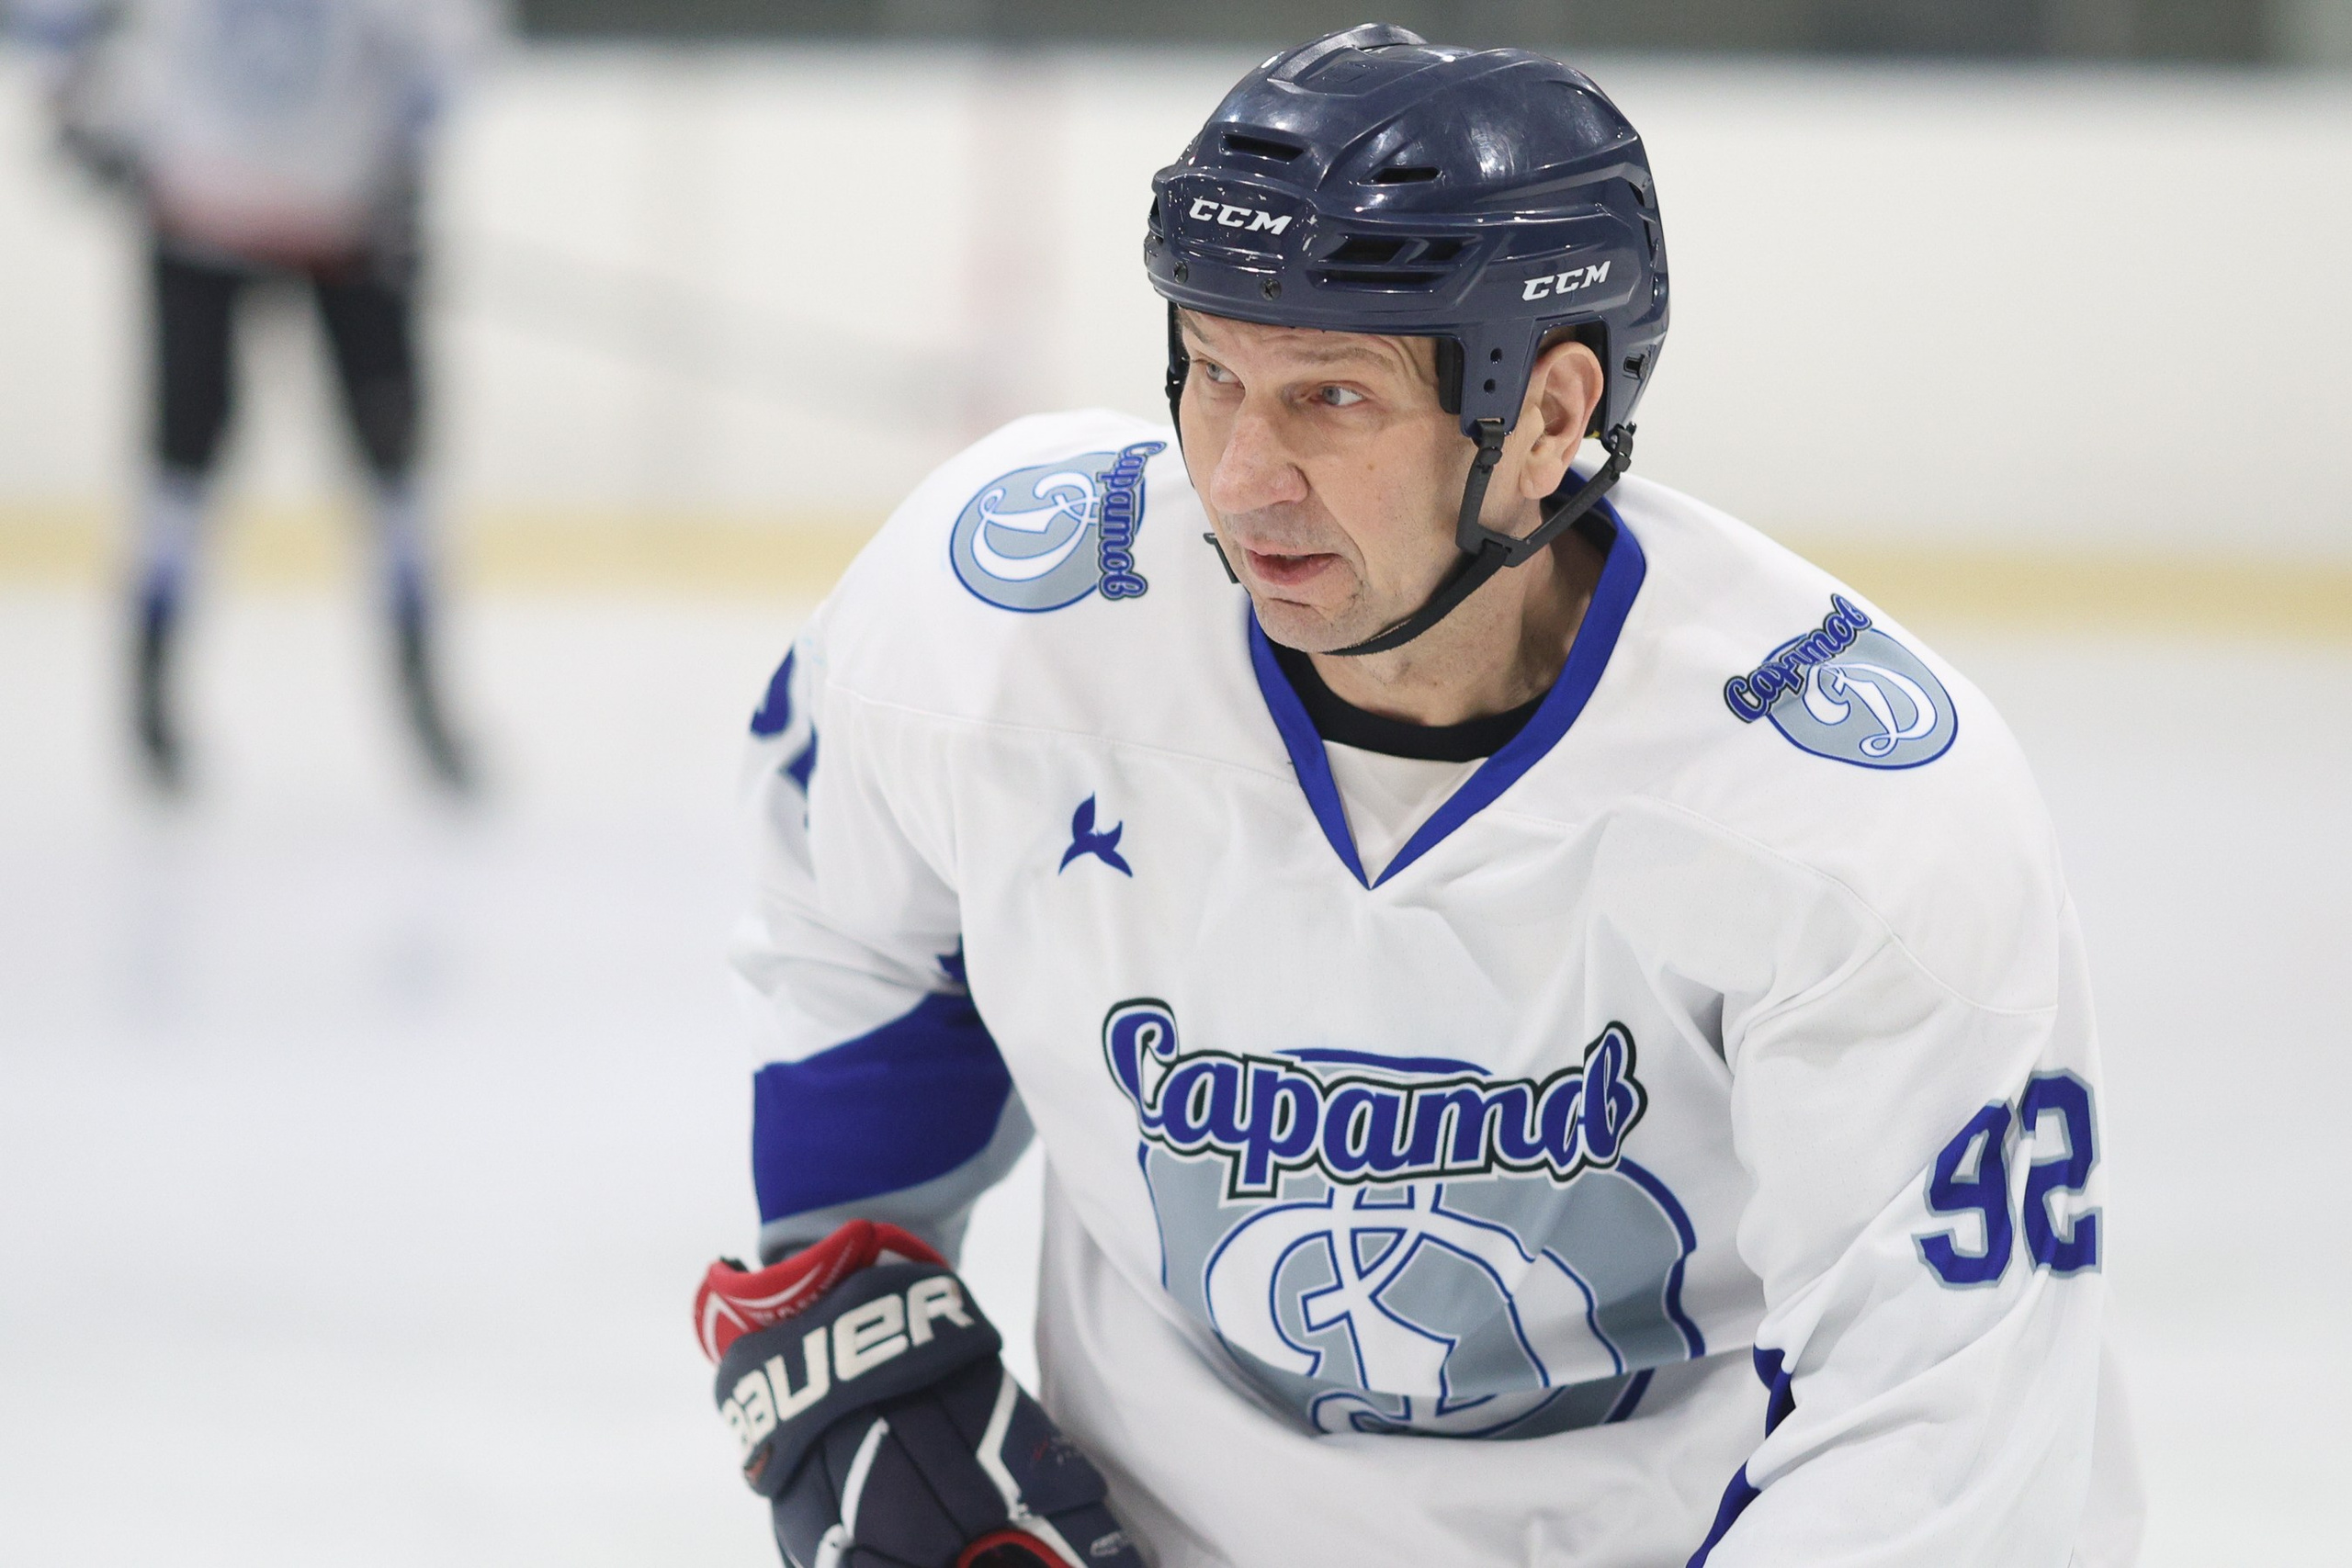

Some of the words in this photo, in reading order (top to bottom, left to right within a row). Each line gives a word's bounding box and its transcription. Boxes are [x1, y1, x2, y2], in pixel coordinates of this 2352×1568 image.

[1188, 197, 1292, 236] CCM
[1521, 261, 1611, 302] CCM
[1911, 1067, 2103, 1290] 92
